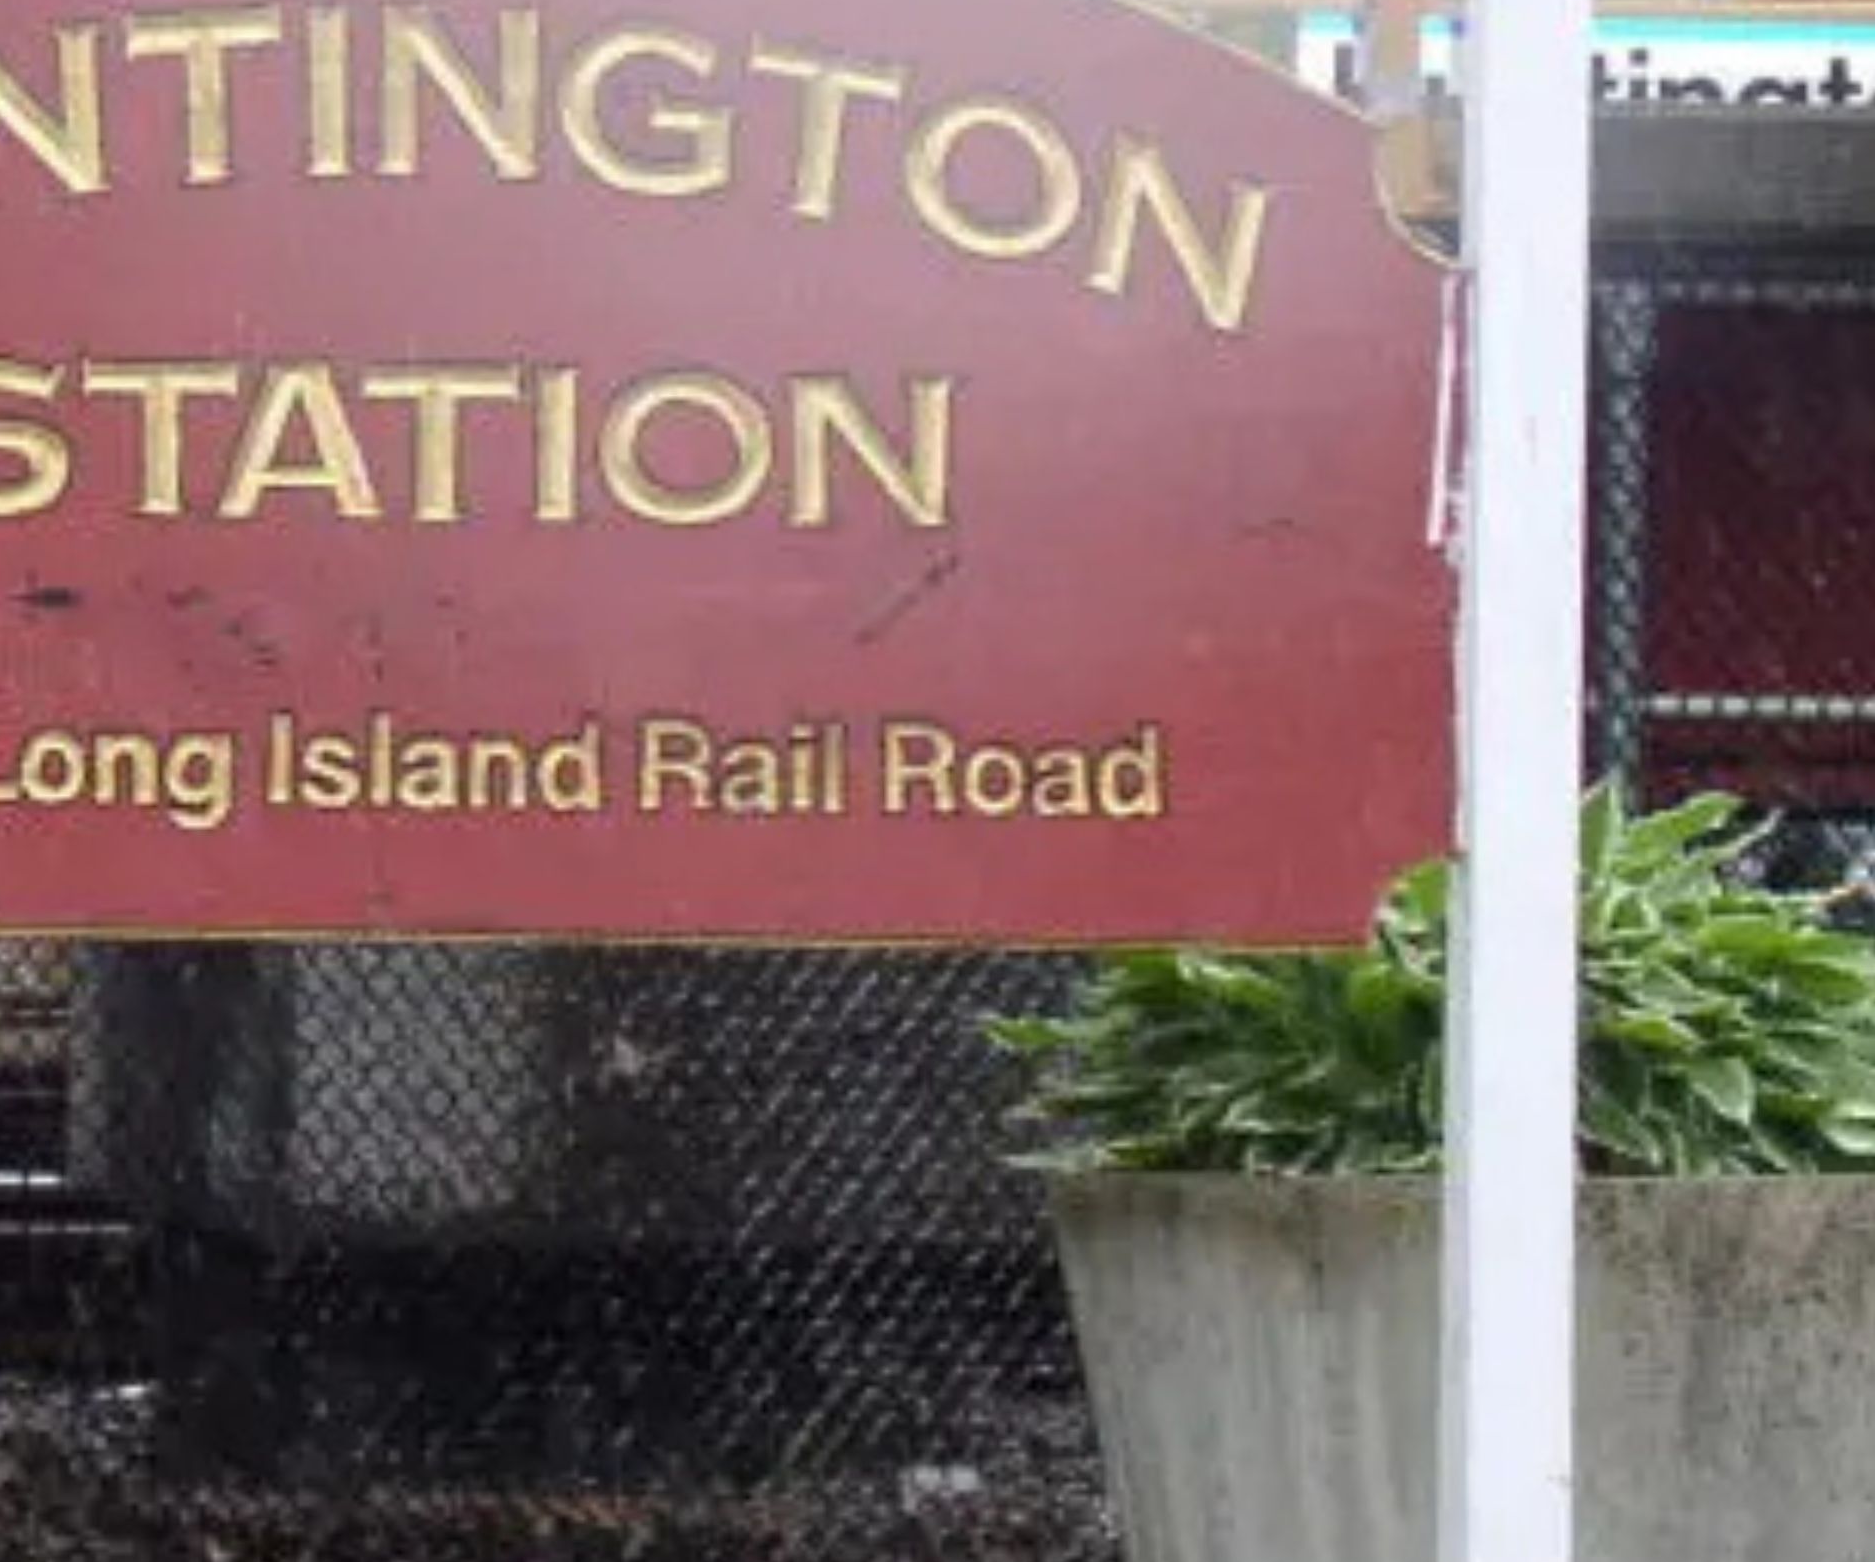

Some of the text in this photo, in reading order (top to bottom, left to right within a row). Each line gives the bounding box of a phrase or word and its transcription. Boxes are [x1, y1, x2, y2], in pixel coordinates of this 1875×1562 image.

[266, 708, 605, 817] Island
[637, 716, 847, 817] Rail
[879, 721, 1163, 820] Road
